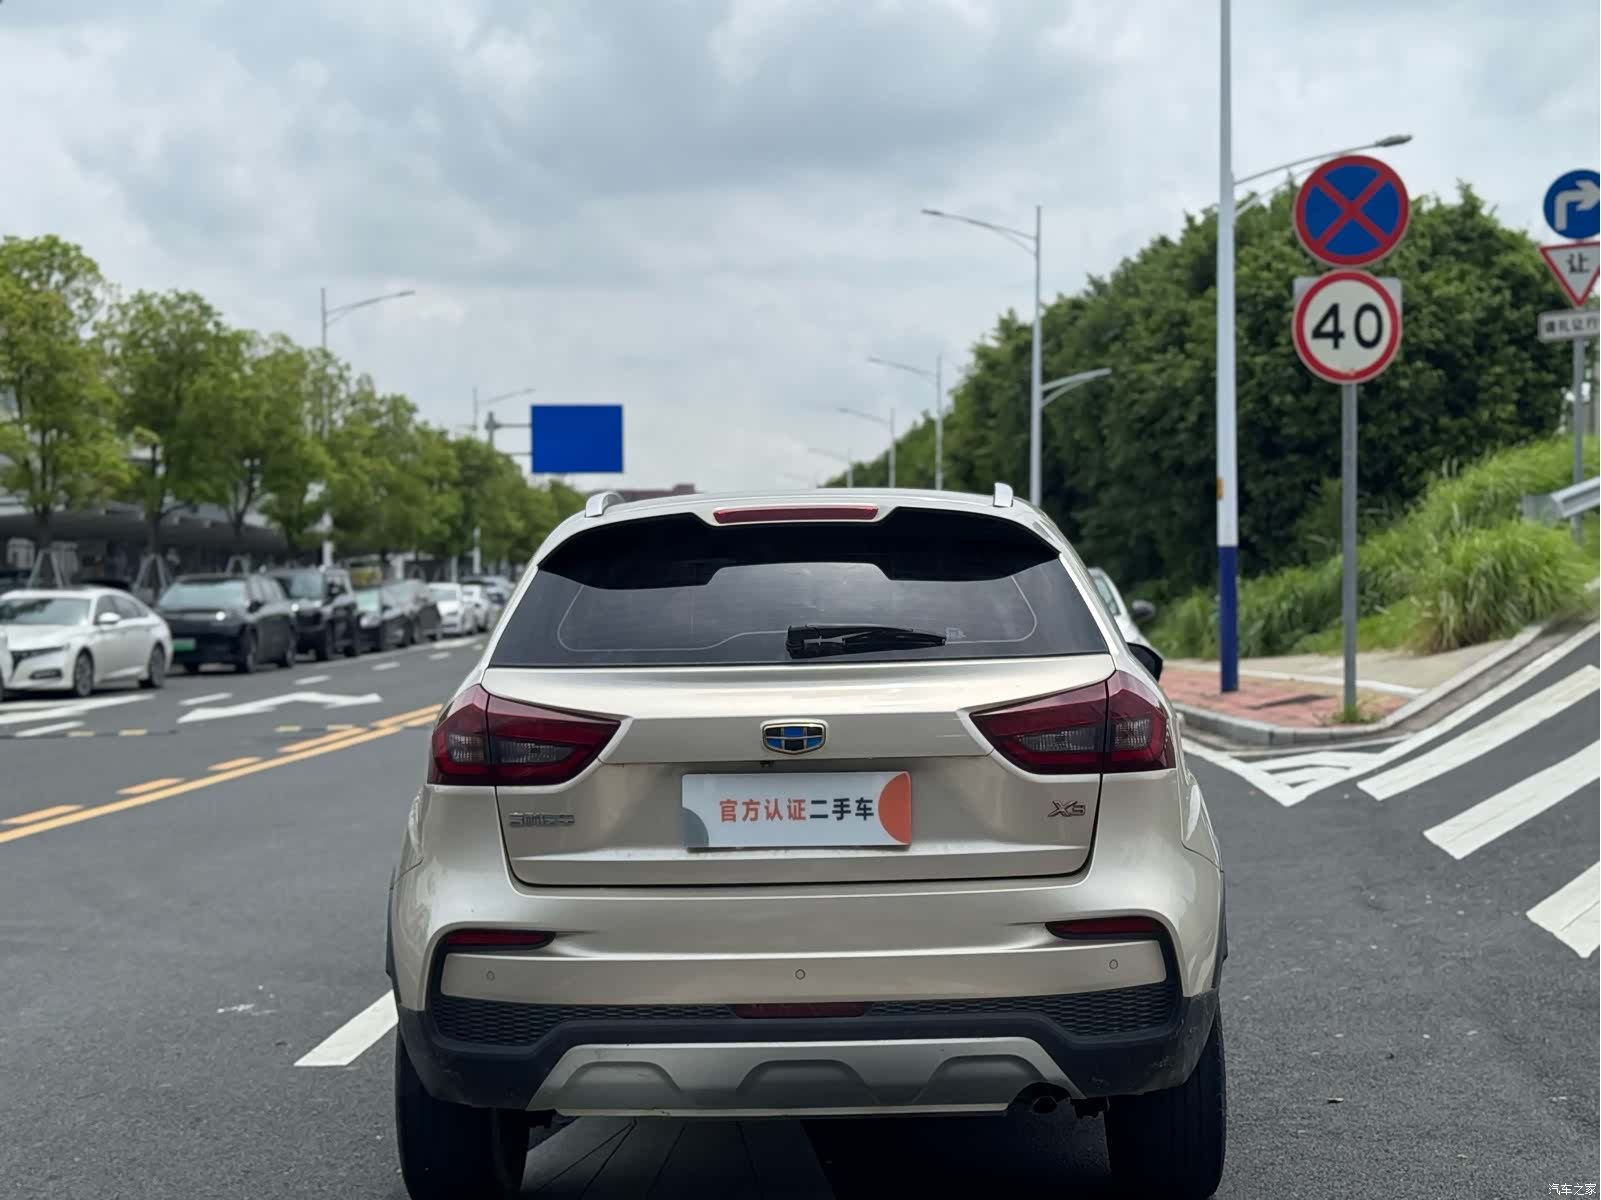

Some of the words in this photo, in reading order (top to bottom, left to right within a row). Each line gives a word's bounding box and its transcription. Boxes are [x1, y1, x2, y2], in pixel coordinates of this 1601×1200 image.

[1567, 252, 1590, 274] 让
[1311, 302, 1384, 350] 40
[719, 797, 875, 823] 官方认证二手车
